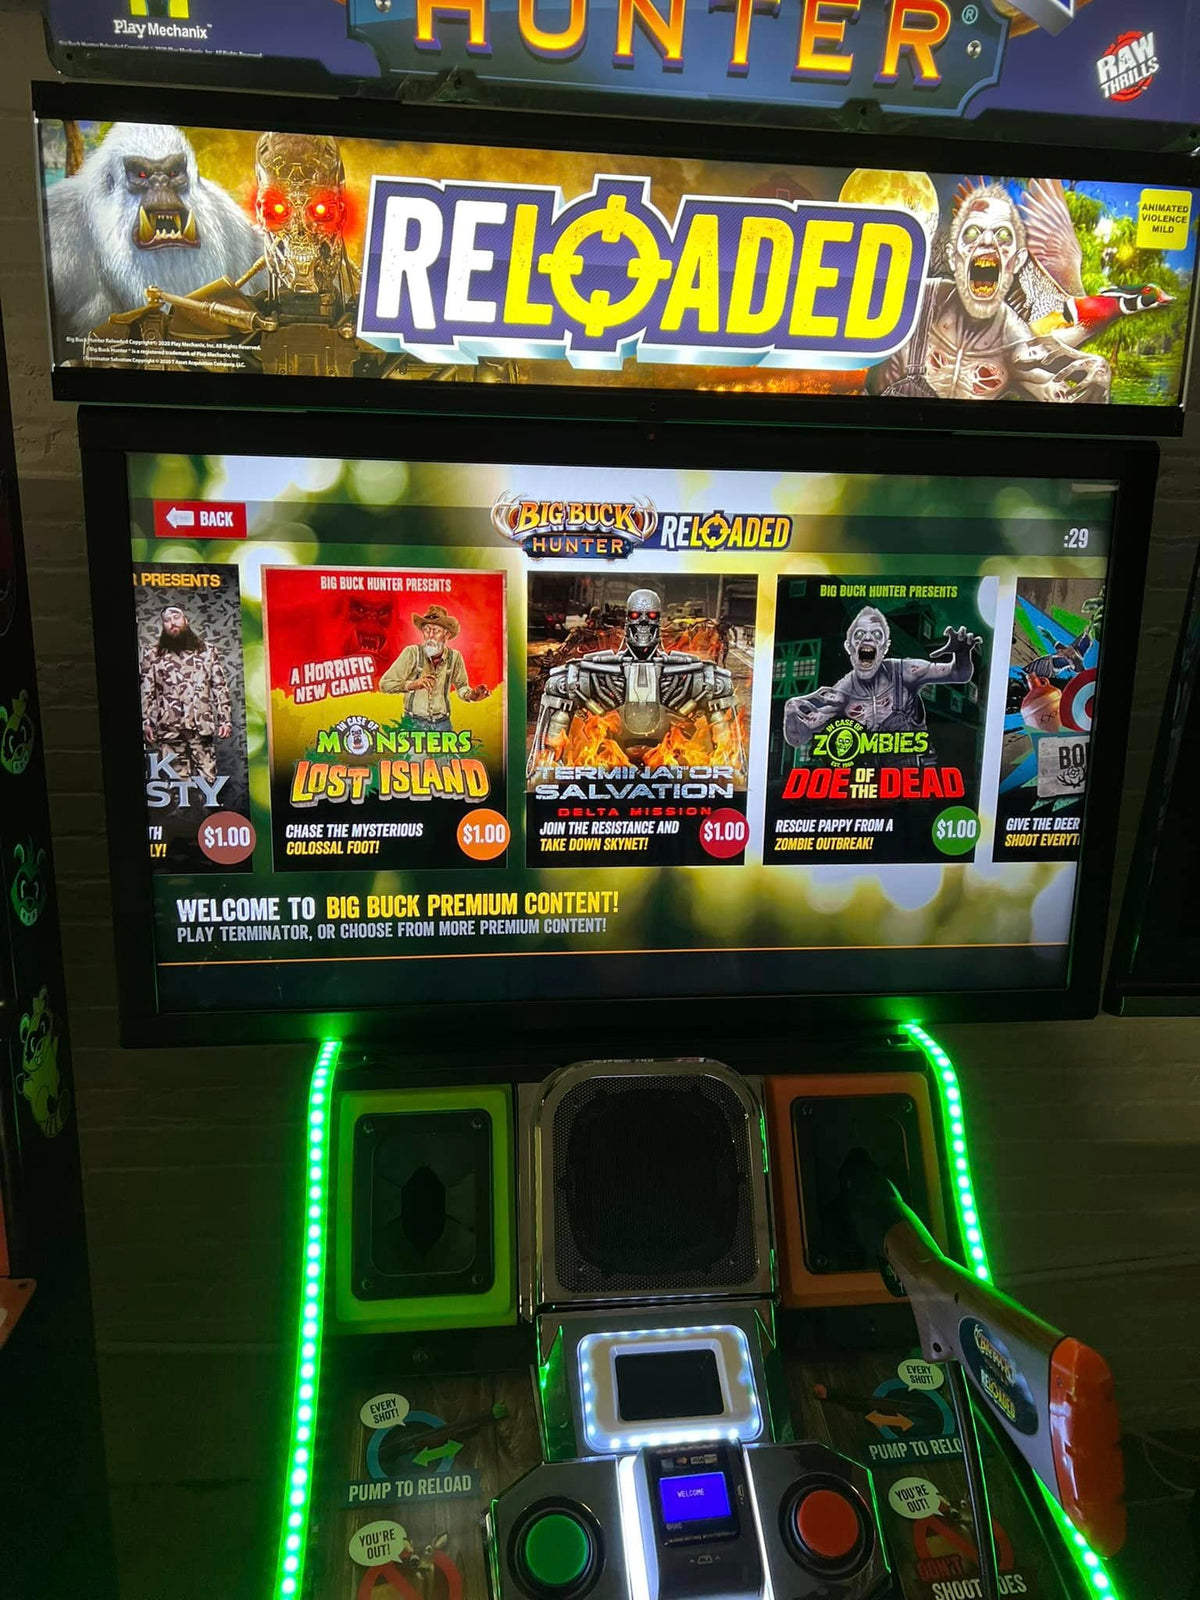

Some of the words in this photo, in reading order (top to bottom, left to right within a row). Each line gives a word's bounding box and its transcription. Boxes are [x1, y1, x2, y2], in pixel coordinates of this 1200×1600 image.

[113, 19, 146, 38] Play
[415, 0, 951, 84] HUNTER
[1097, 32, 1155, 84] RAW
[1101, 56, 1160, 98] THRILLS
[1142, 203, 1189, 213] ANIMATED
[1142, 214, 1187, 224] VIOLENCE
[1152, 225, 1174, 234] MILD
[375, 194, 913, 340] RELOADED
[200, 510, 234, 527] BACK
[514, 501, 563, 533] BIG
[567, 501, 642, 534] BUCK
[661, 513, 791, 549] RELOADED
[1064, 528, 1089, 549] :29
[532, 537, 624, 553] HUNTER
[141, 572, 221, 588] PRESENTS
[320, 576, 337, 590] BIG
[340, 576, 364, 591] BUCK
[367, 577, 403, 591] HUNTER
[406, 578, 451, 592] PRESENTS
[820, 585, 836, 597] BIG
[840, 585, 866, 597] BUCK
[869, 586, 906, 598] HUNTER
[909, 586, 958, 598] PRESENTS
[291, 668, 300, 685] A
[304, 656, 375, 685] HORRIFIC
[296, 683, 325, 703] NEW
[331, 675, 373, 696] GAME!
[337, 721, 346, 732] IN
[347, 716, 366, 726] CASE
[368, 720, 379, 731] OF
[835, 719, 854, 728] CASE
[854, 723, 863, 732] OF
[813, 728, 930, 760] ZOMBIES
[292, 761, 370, 802] LOST
[380, 759, 490, 799] ISLAND
[536, 765, 734, 780] TERMINATOR
[855, 768, 875, 783] OF
[535, 783, 734, 800] SALVATION
[782, 768, 851, 799] DOE
[850, 784, 878, 799] THE
[880, 768, 965, 799] DEAD
[557, 807, 620, 817] DELTA
[630, 806, 712, 817] MISSION
[285, 824, 323, 839] CHASE
[327, 824, 349, 838] THE
[351, 823, 423, 838] MYSTERIOUS
[540, 821, 567, 836] JOIN
[569, 821, 588, 835] THE
[589, 821, 655, 835] RESISTANCE
[657, 820, 680, 834] AND
[703, 821, 745, 842] $1.00
[775, 819, 817, 833] RESCUE
[819, 819, 852, 833] PAPPY
[854, 818, 883, 832] FROM
[884, 818, 893, 832] A
[936, 819, 977, 839] $1.00
[1006, 818, 1031, 831] GIVE
[1032, 818, 1053, 830] THE
[1053, 817, 1081, 830] DEER
[204, 826, 251, 848] $1.00
[463, 824, 505, 844] $1.00
[1005, 834, 1039, 847] SHOOT
[286, 841, 344, 855] COLOSSAL
[348, 840, 379, 854] FOOT!
[540, 839, 566, 851] TAKE
[569, 838, 601, 851] DOWN
[603, 837, 649, 851] SKYNET!
[774, 837, 814, 850] ZOMBIE
[816, 836, 873, 850] OUTBREAK!
[176, 897, 280, 922] WELCOME
[288, 897, 315, 920] TO
[327, 896, 360, 919] BIG
[367, 894, 420, 918] BUCK
[428, 893, 518, 917] PREMIUM
[524, 891, 619, 915] CONTENT!
[177, 926, 214, 943] PLAY
[219, 924, 313, 942] TERMINATOR,
[317, 924, 335, 939] OR
[340, 922, 393, 939] CHOOSE
[397, 921, 434, 937] FROM
[439, 920, 475, 937] MORE
[480, 919, 539, 935] PREMIUM
[543, 918, 607, 934] CONTENT!
[906, 1365, 931, 1375] EVERY
[910, 1373, 934, 1385] SHOT!
[369, 1398, 397, 1414] EVERY
[374, 1409, 400, 1424] SHOT!
[868, 1442, 907, 1460] PUMP
[910, 1441, 929, 1457] TO
[929, 1437, 963, 1455] RELO
[348, 1482, 392, 1502] PUMP
[396, 1480, 413, 1498] TO
[418, 1474, 472, 1496] RELOAD
[677, 1488, 705, 1499] WELCOME
[894, 1484, 929, 1502] YOU'RE
[906, 1498, 930, 1513] OUT!
[359, 1528, 396, 1547] YOU'RE
[366, 1544, 391, 1560] OUT!
[932, 1579, 983, 1600] SHOOT
